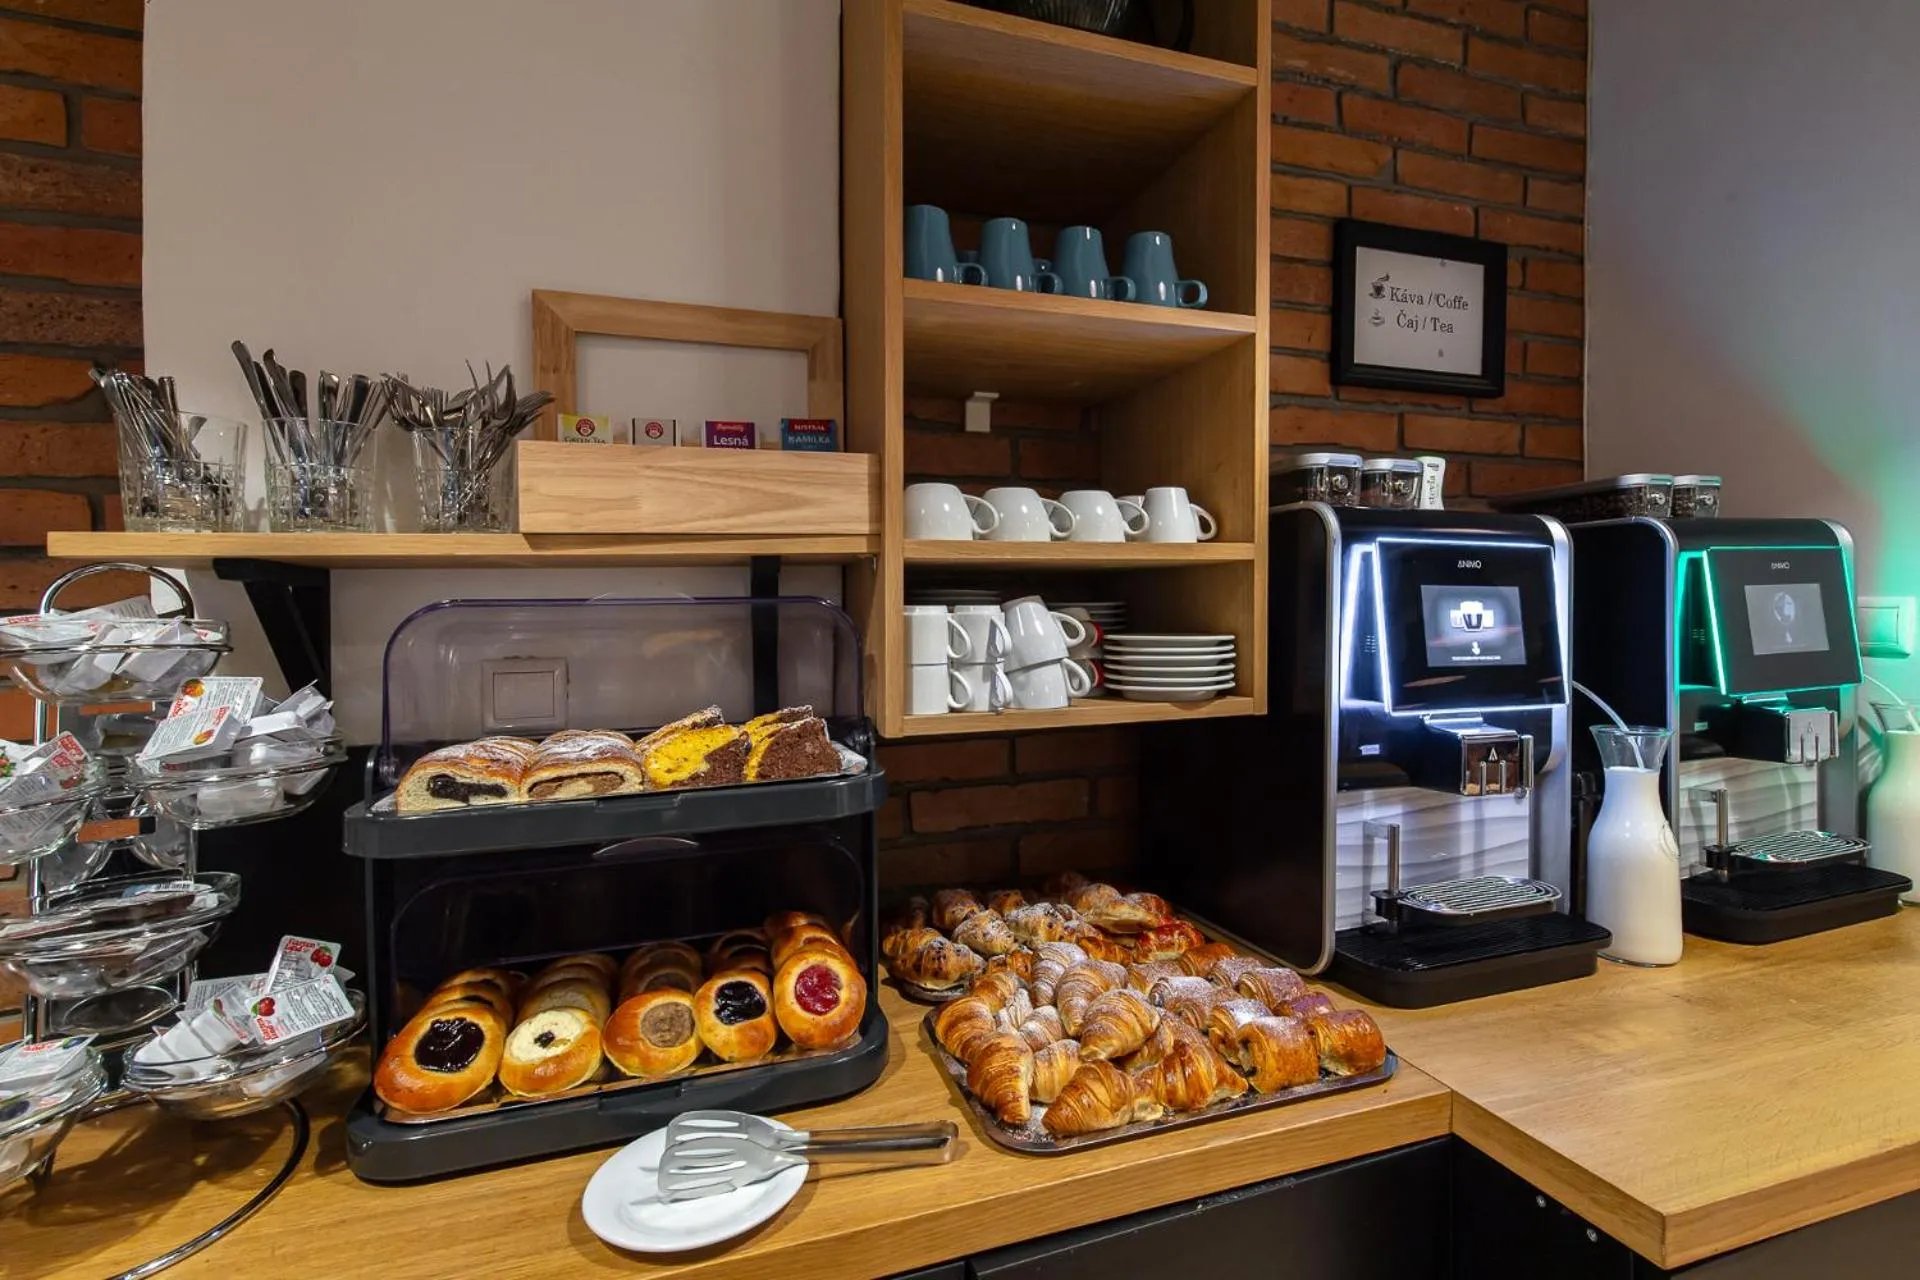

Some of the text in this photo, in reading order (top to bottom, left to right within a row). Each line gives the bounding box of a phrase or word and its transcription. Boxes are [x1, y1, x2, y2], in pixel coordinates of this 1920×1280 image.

[1389, 286, 1424, 305] Káva
[1436, 292, 1469, 310] Coffe
[1396, 309, 1419, 332] Čaj
[1430, 316, 1455, 333] Tea
[713, 433, 749, 447] Lesná
